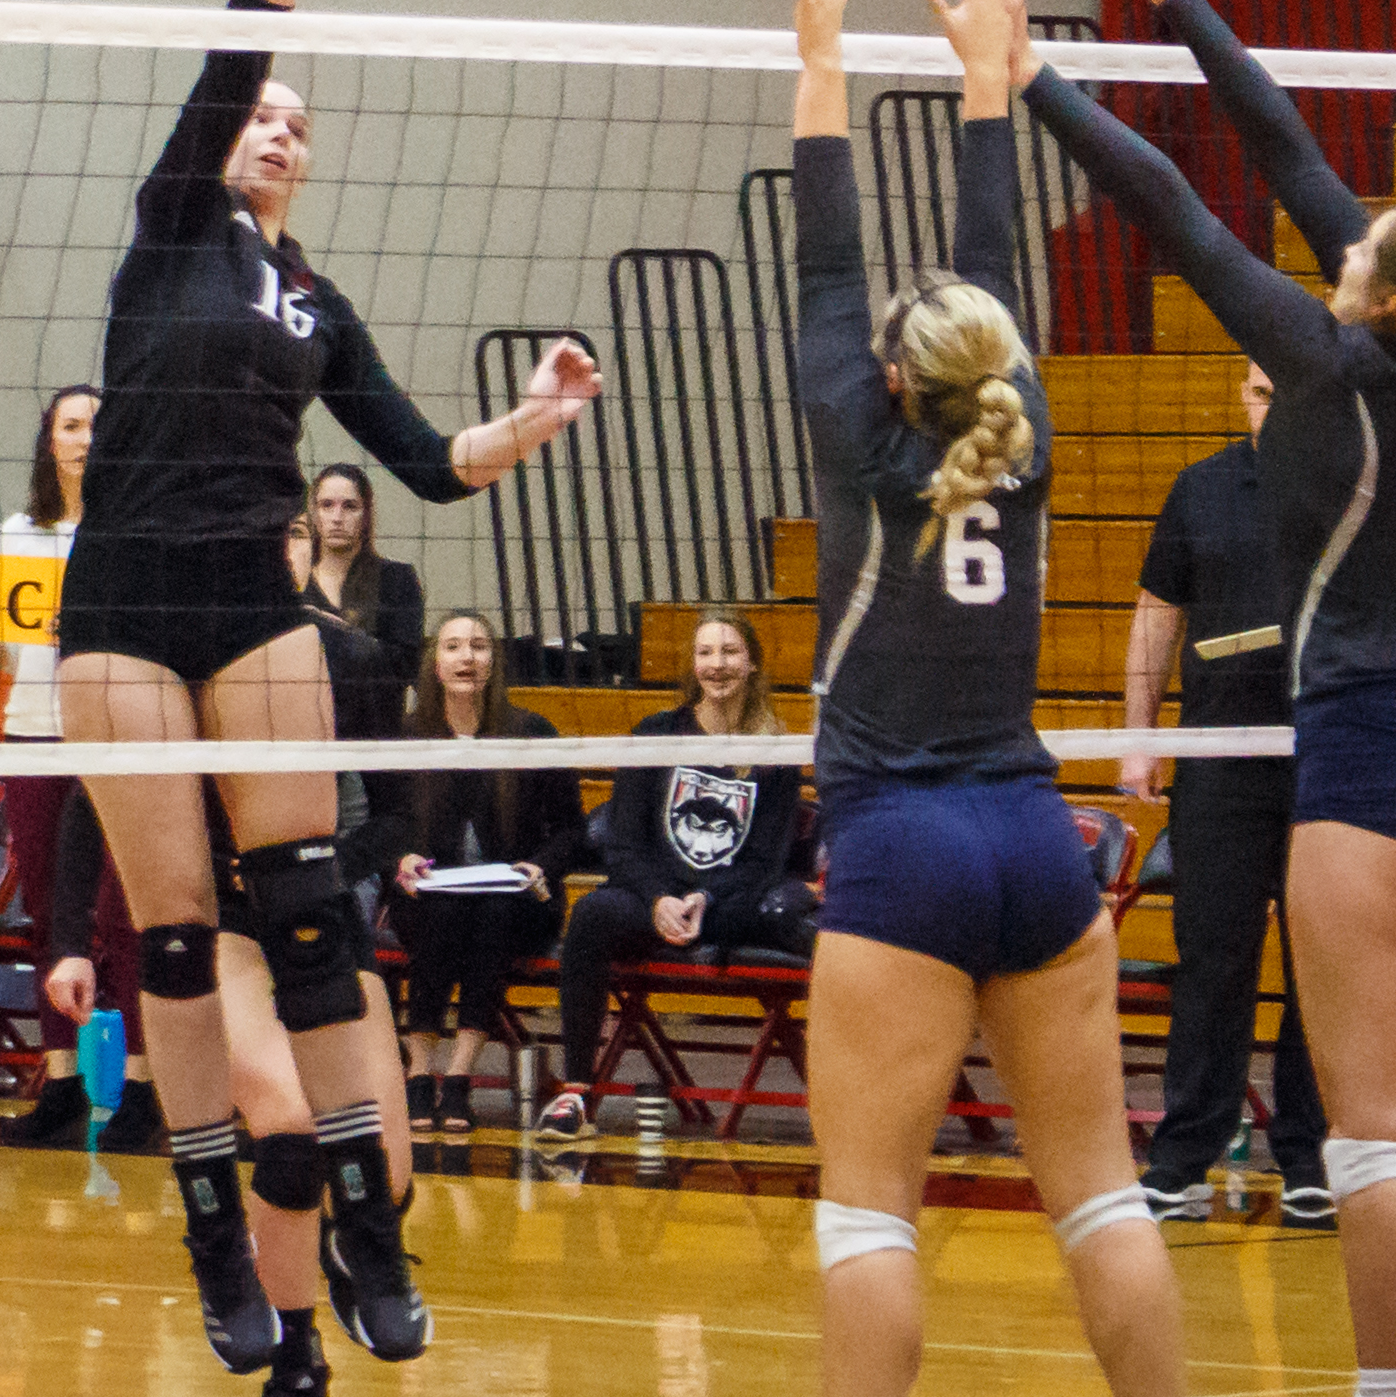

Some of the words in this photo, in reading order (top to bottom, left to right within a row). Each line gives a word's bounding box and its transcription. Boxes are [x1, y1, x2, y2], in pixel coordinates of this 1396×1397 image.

[251, 259, 316, 338] 16
[942, 499, 1006, 604] 6
[7, 580, 43, 630] C
